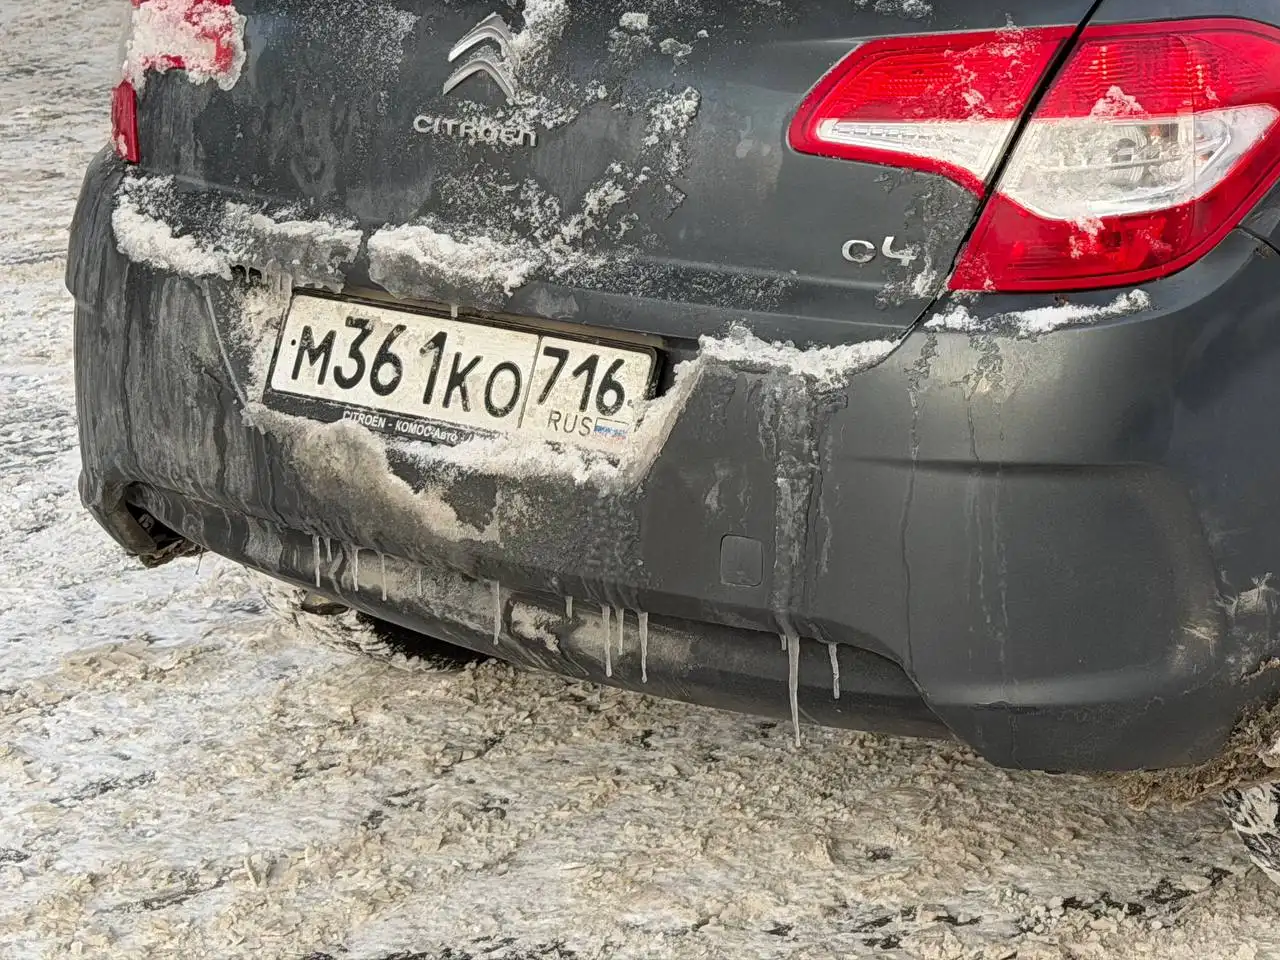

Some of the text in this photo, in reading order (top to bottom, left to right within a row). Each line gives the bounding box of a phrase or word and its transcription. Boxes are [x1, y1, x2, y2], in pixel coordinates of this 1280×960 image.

[841, 236, 918, 267] C4
[537, 345, 626, 417] 716
[547, 409, 593, 437] RUS
